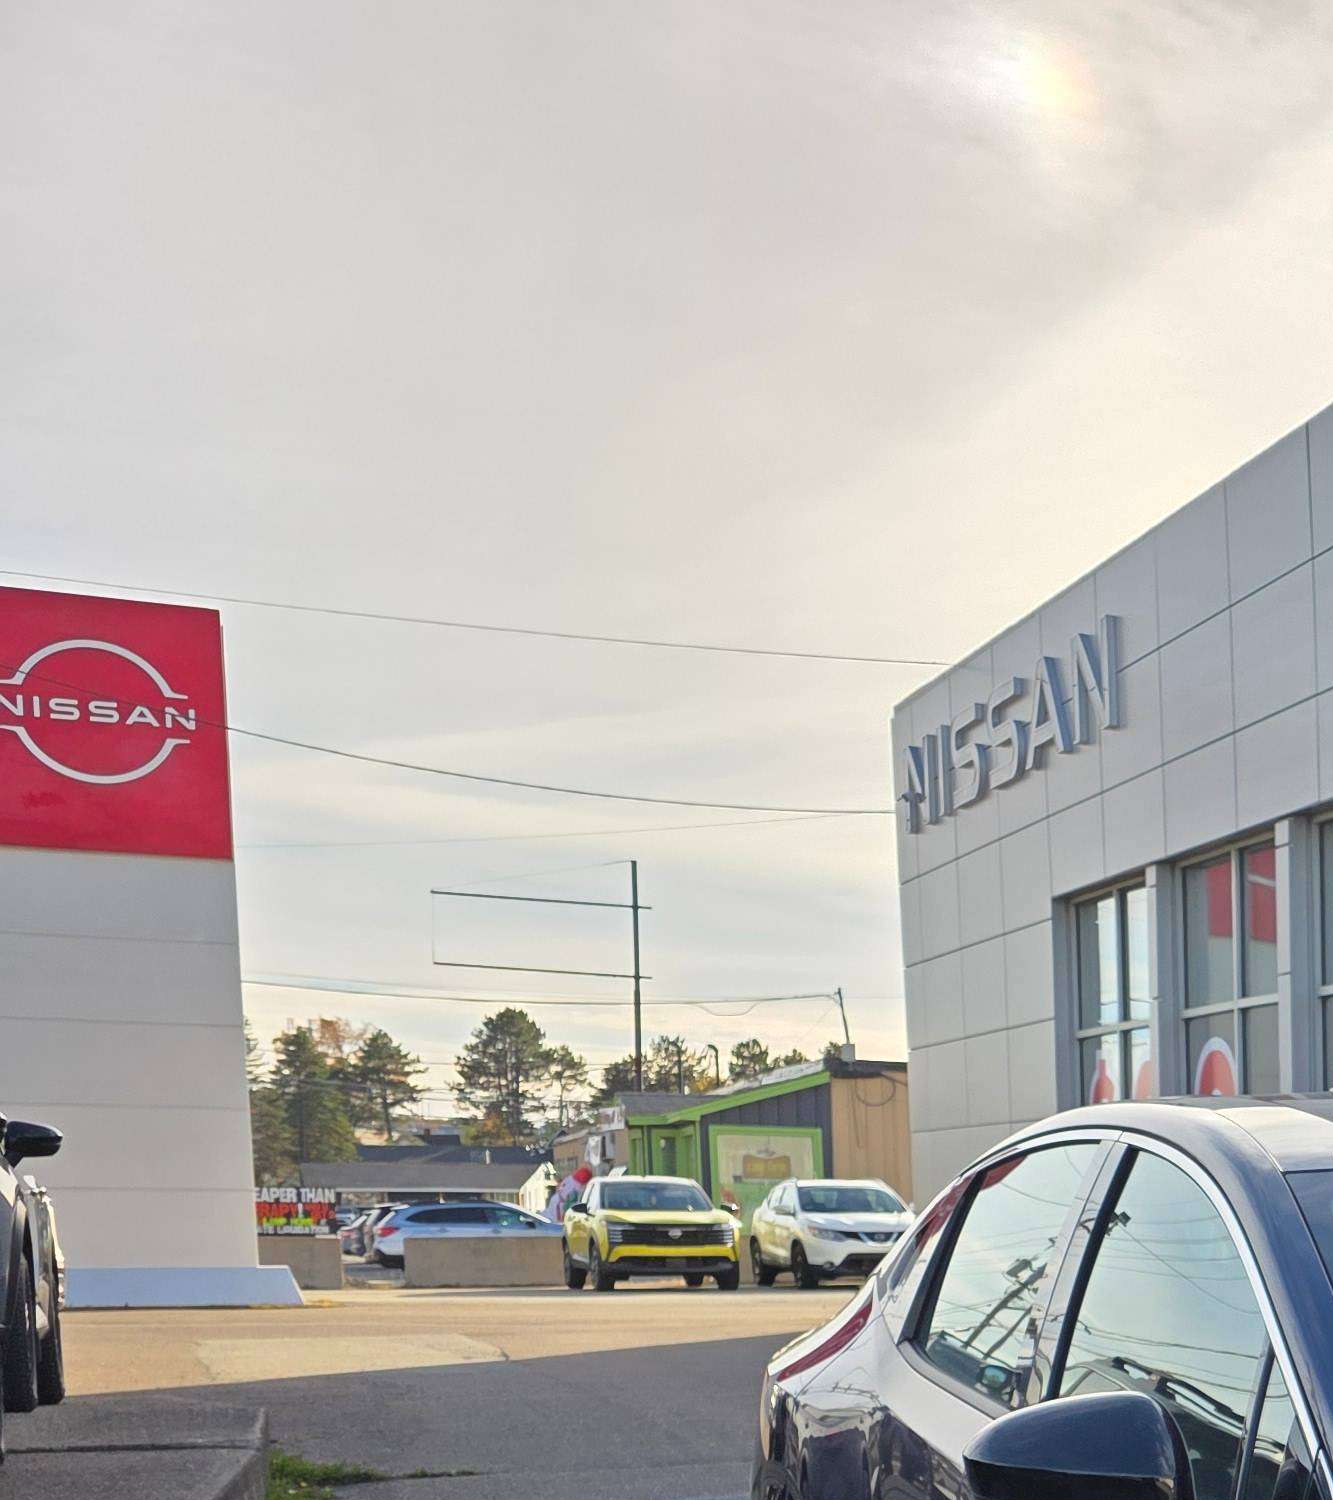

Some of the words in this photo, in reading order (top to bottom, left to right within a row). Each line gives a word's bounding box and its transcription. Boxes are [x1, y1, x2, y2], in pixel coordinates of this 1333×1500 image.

[0, 693, 196, 731] NISSAN
[899, 613, 1121, 835] NISSAN
[300, 1187, 336, 1203] THAN
